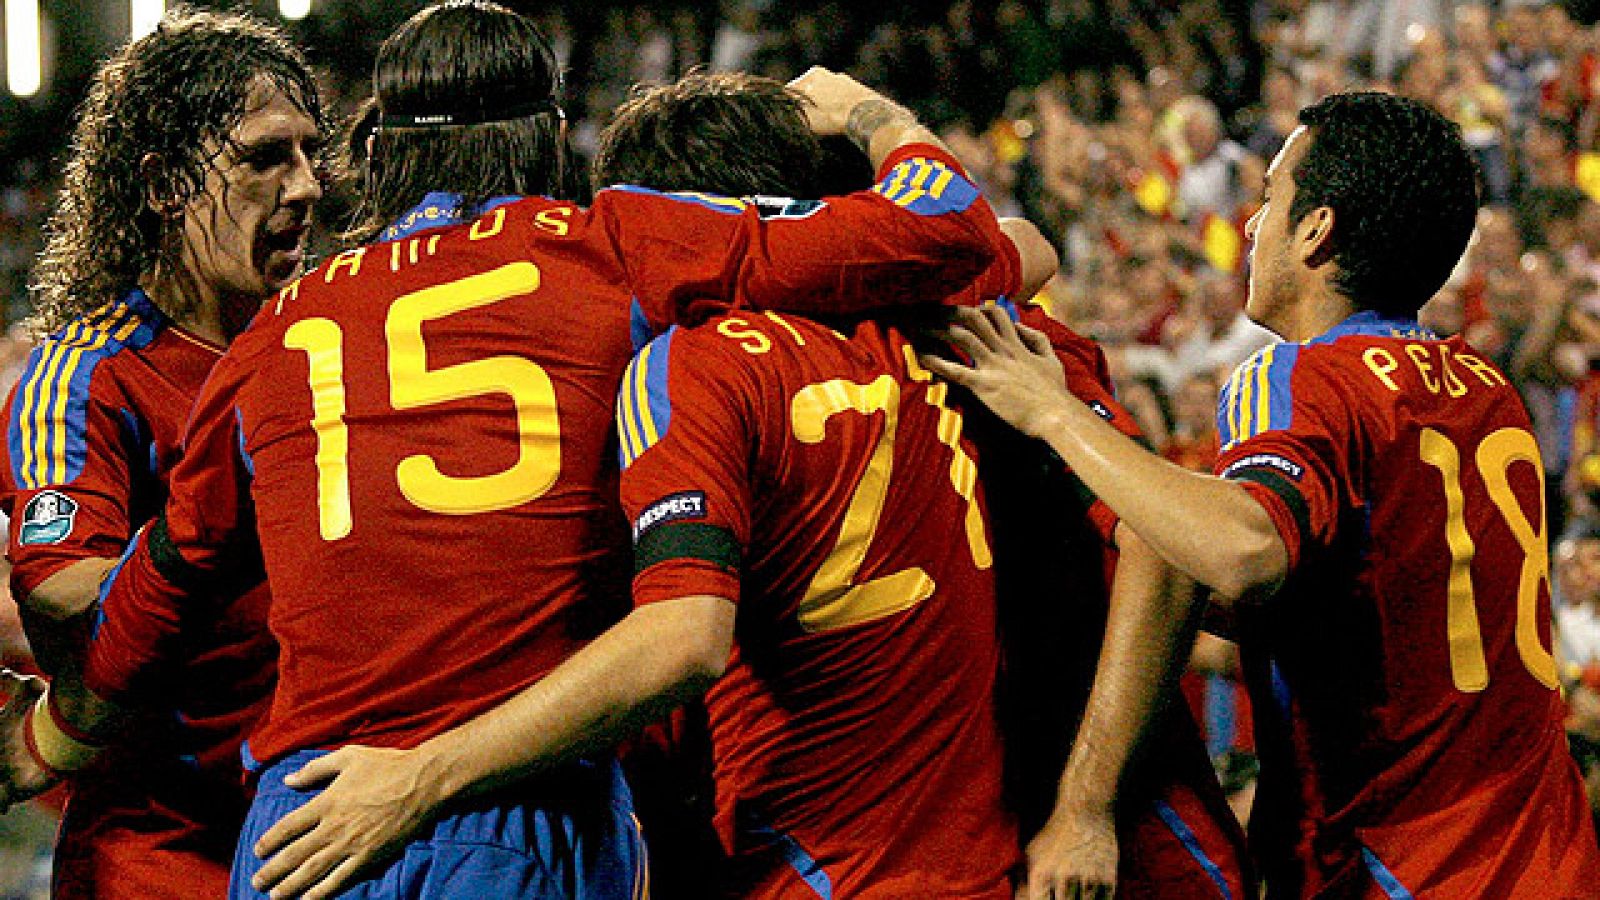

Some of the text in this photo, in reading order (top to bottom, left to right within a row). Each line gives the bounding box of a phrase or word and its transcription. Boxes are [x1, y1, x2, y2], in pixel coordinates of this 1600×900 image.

[283, 261, 561, 541] 15
[638, 497, 701, 531] RESPECT
[791, 344, 993, 634] 21
[1419, 427, 1561, 692] 18
